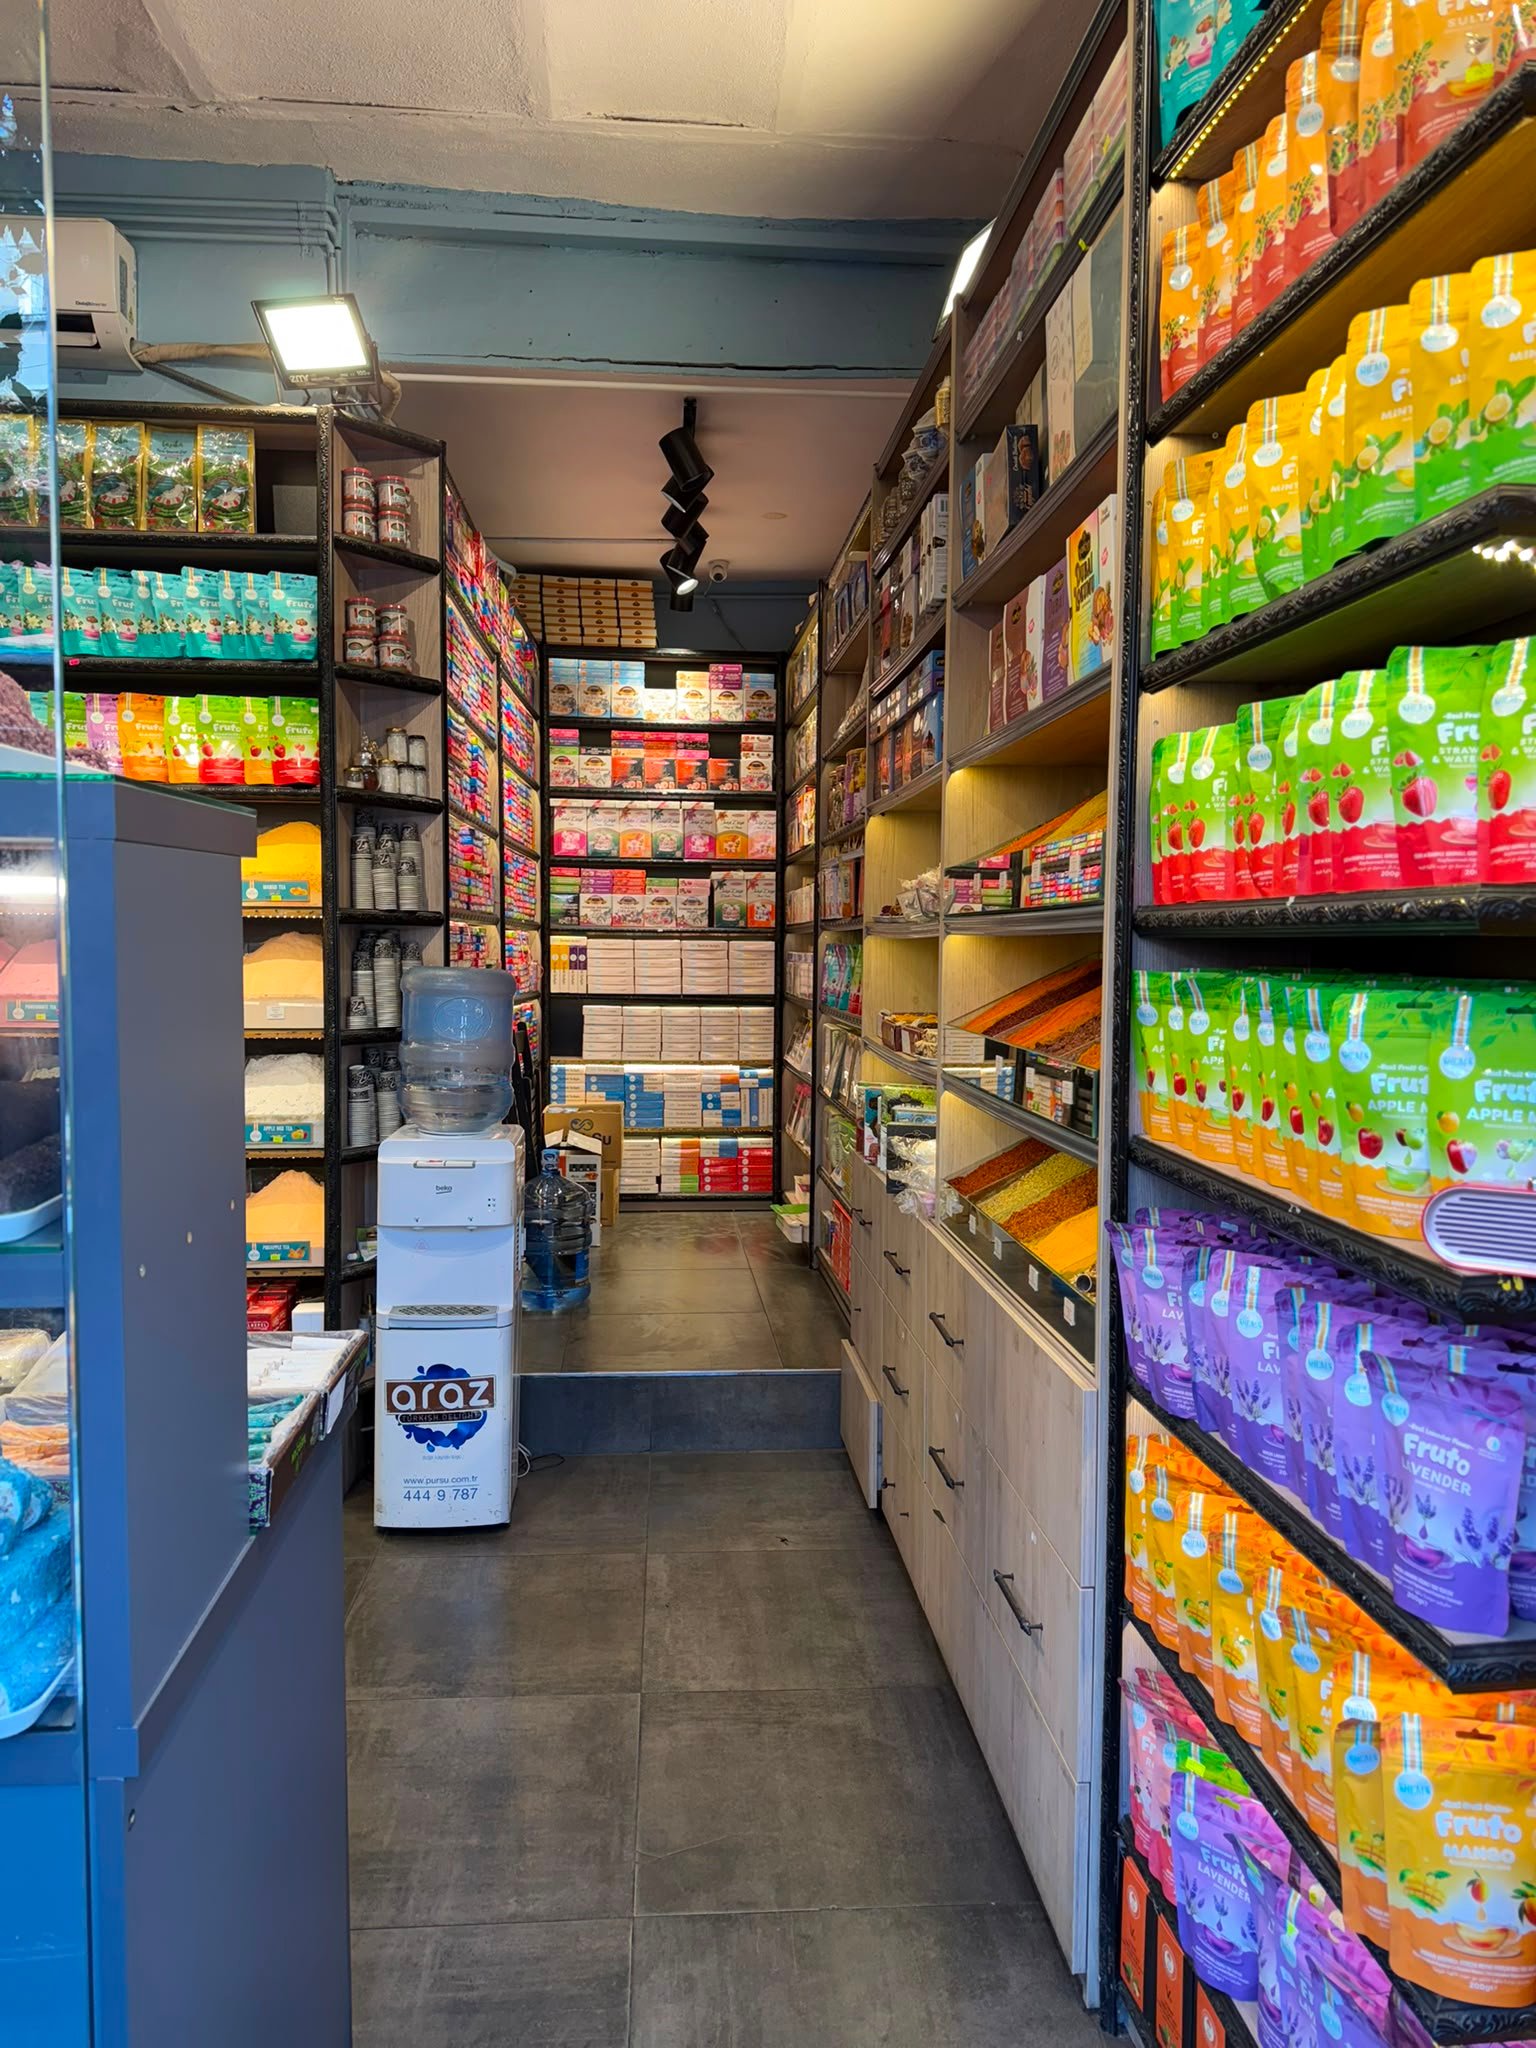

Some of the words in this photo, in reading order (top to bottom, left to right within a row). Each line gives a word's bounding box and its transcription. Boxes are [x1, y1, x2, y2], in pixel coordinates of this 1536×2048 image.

[1368, 1100, 1416, 1113] APPLE
[1466, 1107, 1523, 1123] APPLE
[435, 1184, 453, 1192] beko
[391, 1380, 490, 1411] araz
[1403, 1432, 1471, 1477] Fruto
[403, 1489, 431, 1502] 444
[436, 1489, 446, 1501] 9
[452, 1487, 478, 1501] 787
[1434, 1810, 1523, 1844] Fruto
[1442, 1843, 1516, 1865] MANGO
